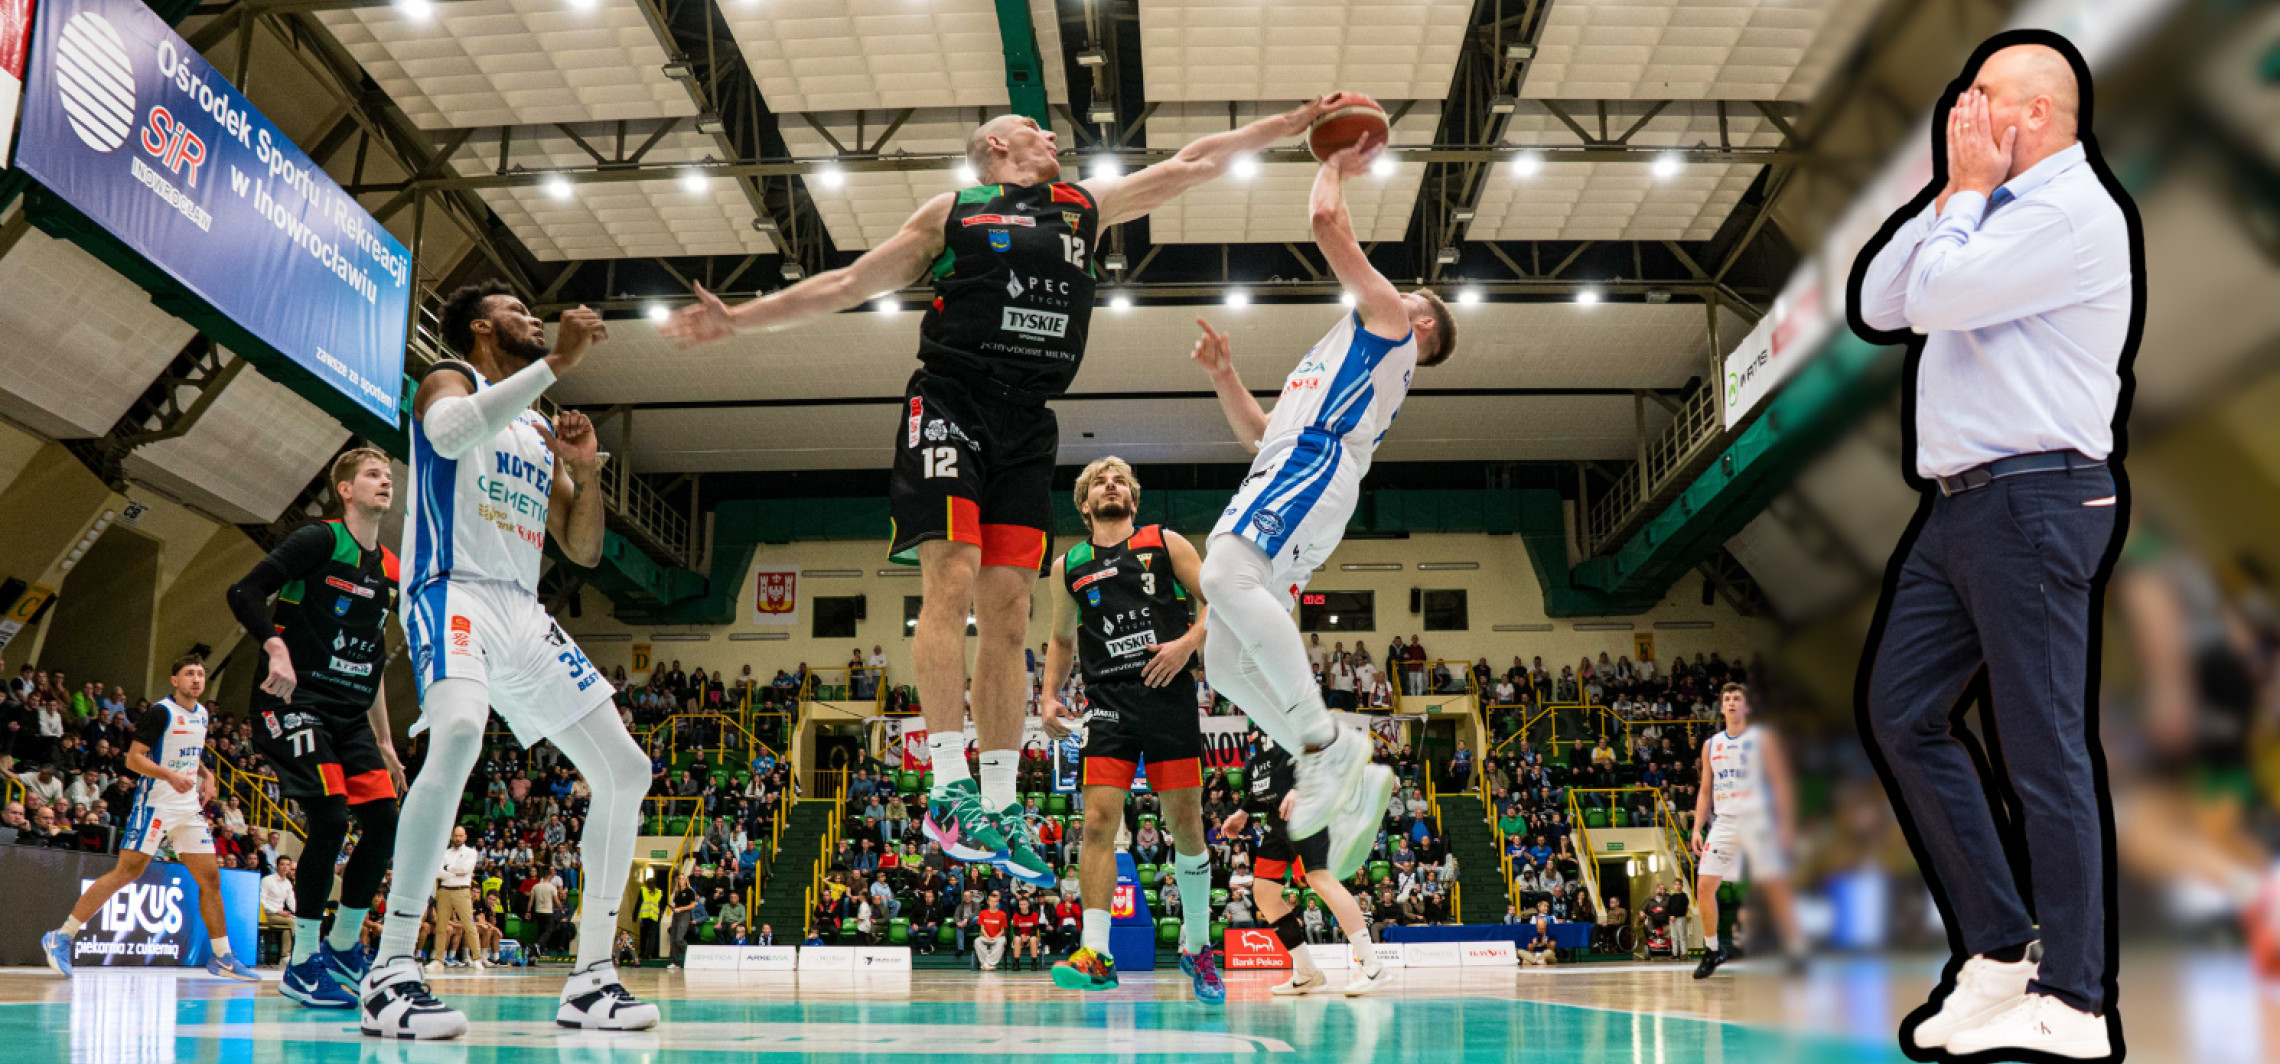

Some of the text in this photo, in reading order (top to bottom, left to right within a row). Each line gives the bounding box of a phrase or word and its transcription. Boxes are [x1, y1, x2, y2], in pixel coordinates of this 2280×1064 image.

[141, 104, 207, 188] SiR
[157, 40, 408, 288] Ośrodek Sportu i Rekreacji
[231, 164, 378, 304] w Inowrocławiu
[1059, 232, 1085, 269] 12
[1029, 277, 1069, 295] PEC
[1008, 311, 1065, 333] TYSKIE
[316, 346, 348, 377] zawsze
[348, 368, 359, 385] ze
[922, 447, 959, 479] 12
[1141, 573, 1155, 595] 3
[17, 596, 39, 617] C
[1117, 607, 1150, 624] PEC
[350, 637, 375, 652] PEC
[1110, 632, 1154, 654] TYSKIE
[559, 646, 593, 678] 34
[635, 654, 649, 669] D
[577, 671, 600, 691] BEST
[286, 728, 316, 757] 77
[79, 877, 184, 934] IEKUŚ
[74, 934, 180, 959] piekarnia z cukiernią
[1232, 957, 1283, 966] Bank Pekao
